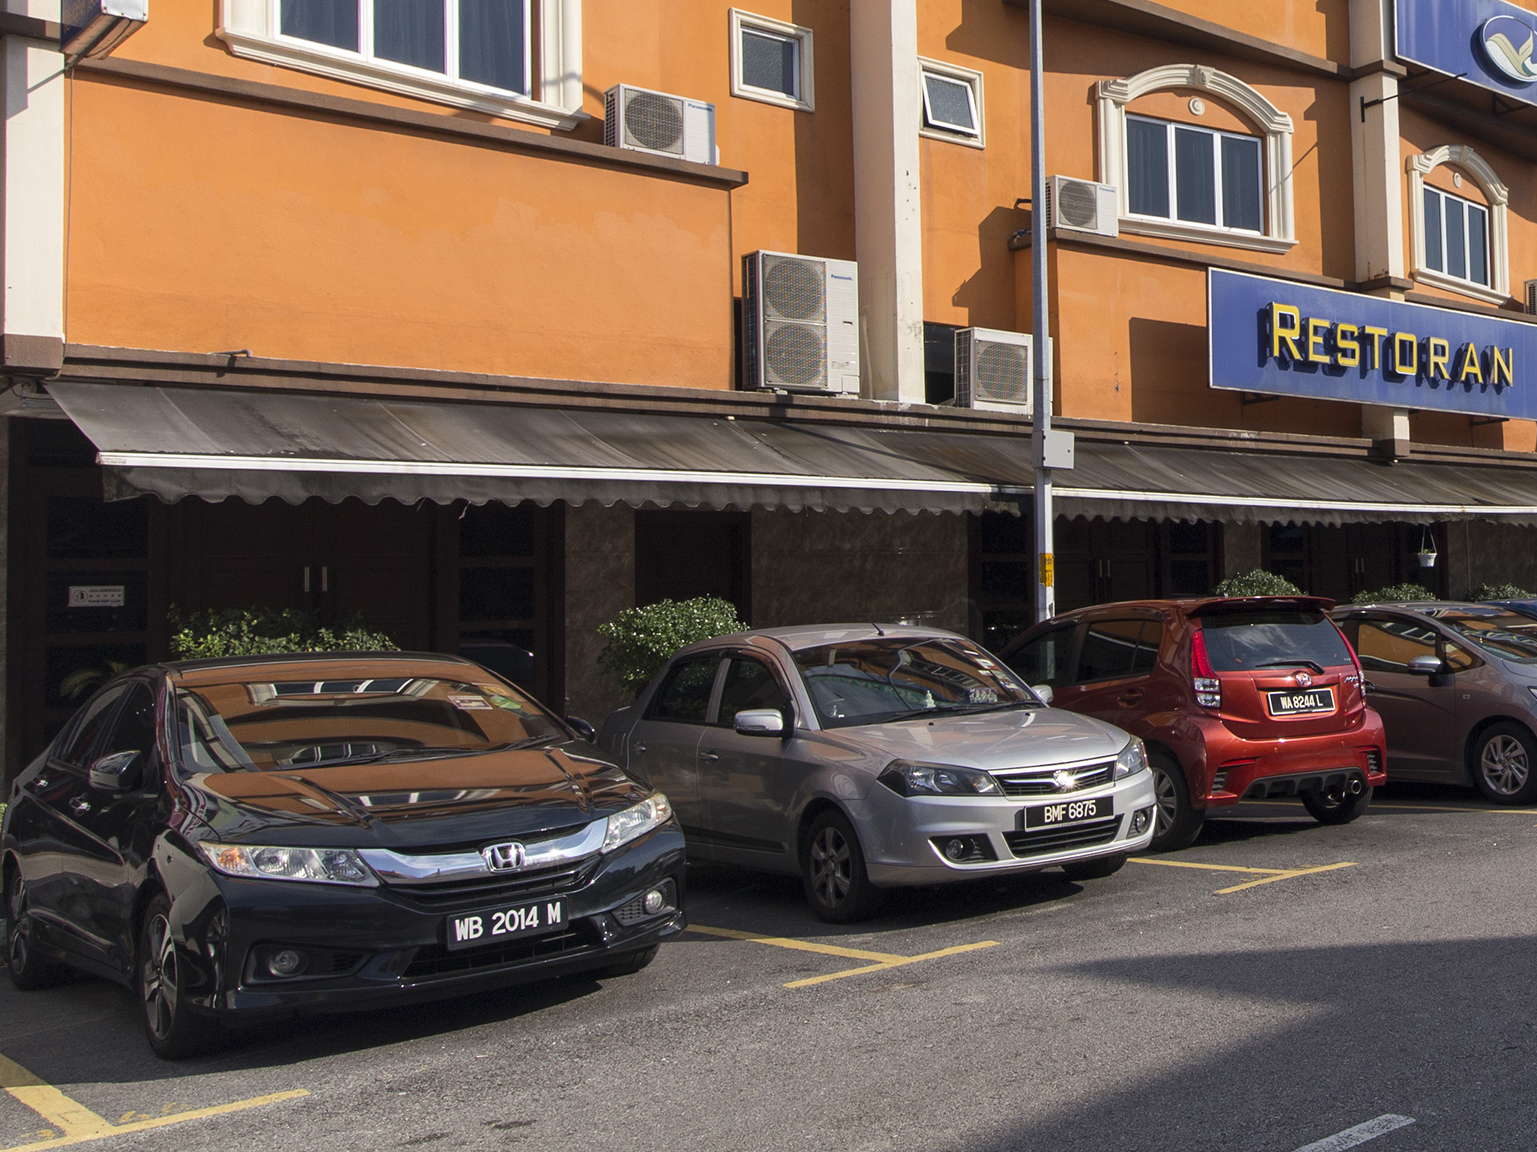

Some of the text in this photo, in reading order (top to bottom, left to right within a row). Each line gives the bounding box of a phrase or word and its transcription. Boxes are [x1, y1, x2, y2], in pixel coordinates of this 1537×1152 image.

[1270, 302, 1514, 387] RESTORAN
[1292, 694, 1315, 708] 8244
[1315, 694, 1323, 706] L
[1044, 800, 1096, 822] BMF 6875
[454, 901, 561, 941] WB 2014 M
